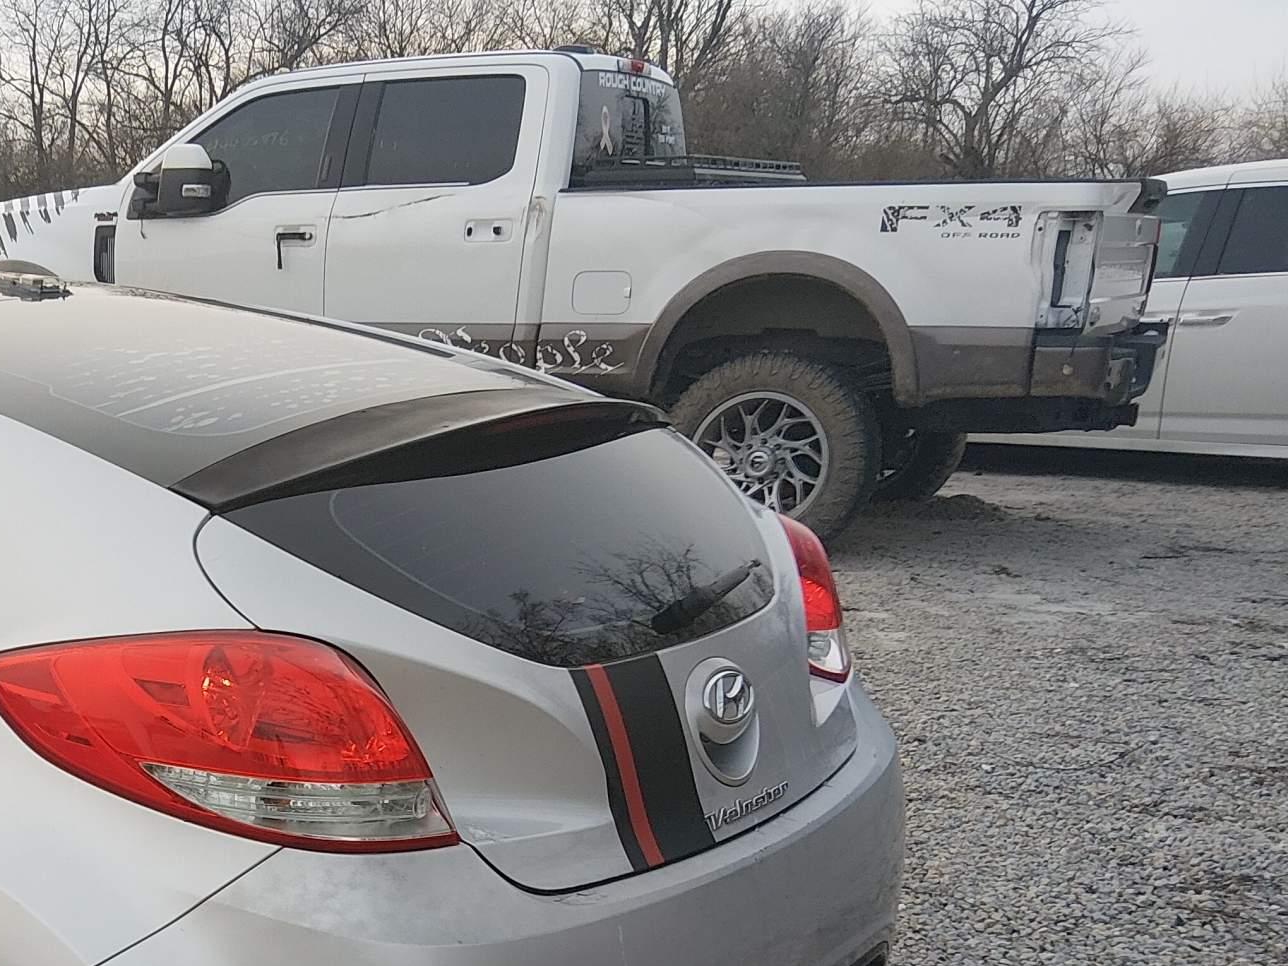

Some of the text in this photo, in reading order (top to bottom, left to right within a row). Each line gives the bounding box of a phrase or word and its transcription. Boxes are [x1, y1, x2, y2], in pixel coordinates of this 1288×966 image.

[599, 72, 666, 97] ROUGH COUNTRY
[880, 205, 1022, 232] FX4
[418, 325, 624, 374] ople
